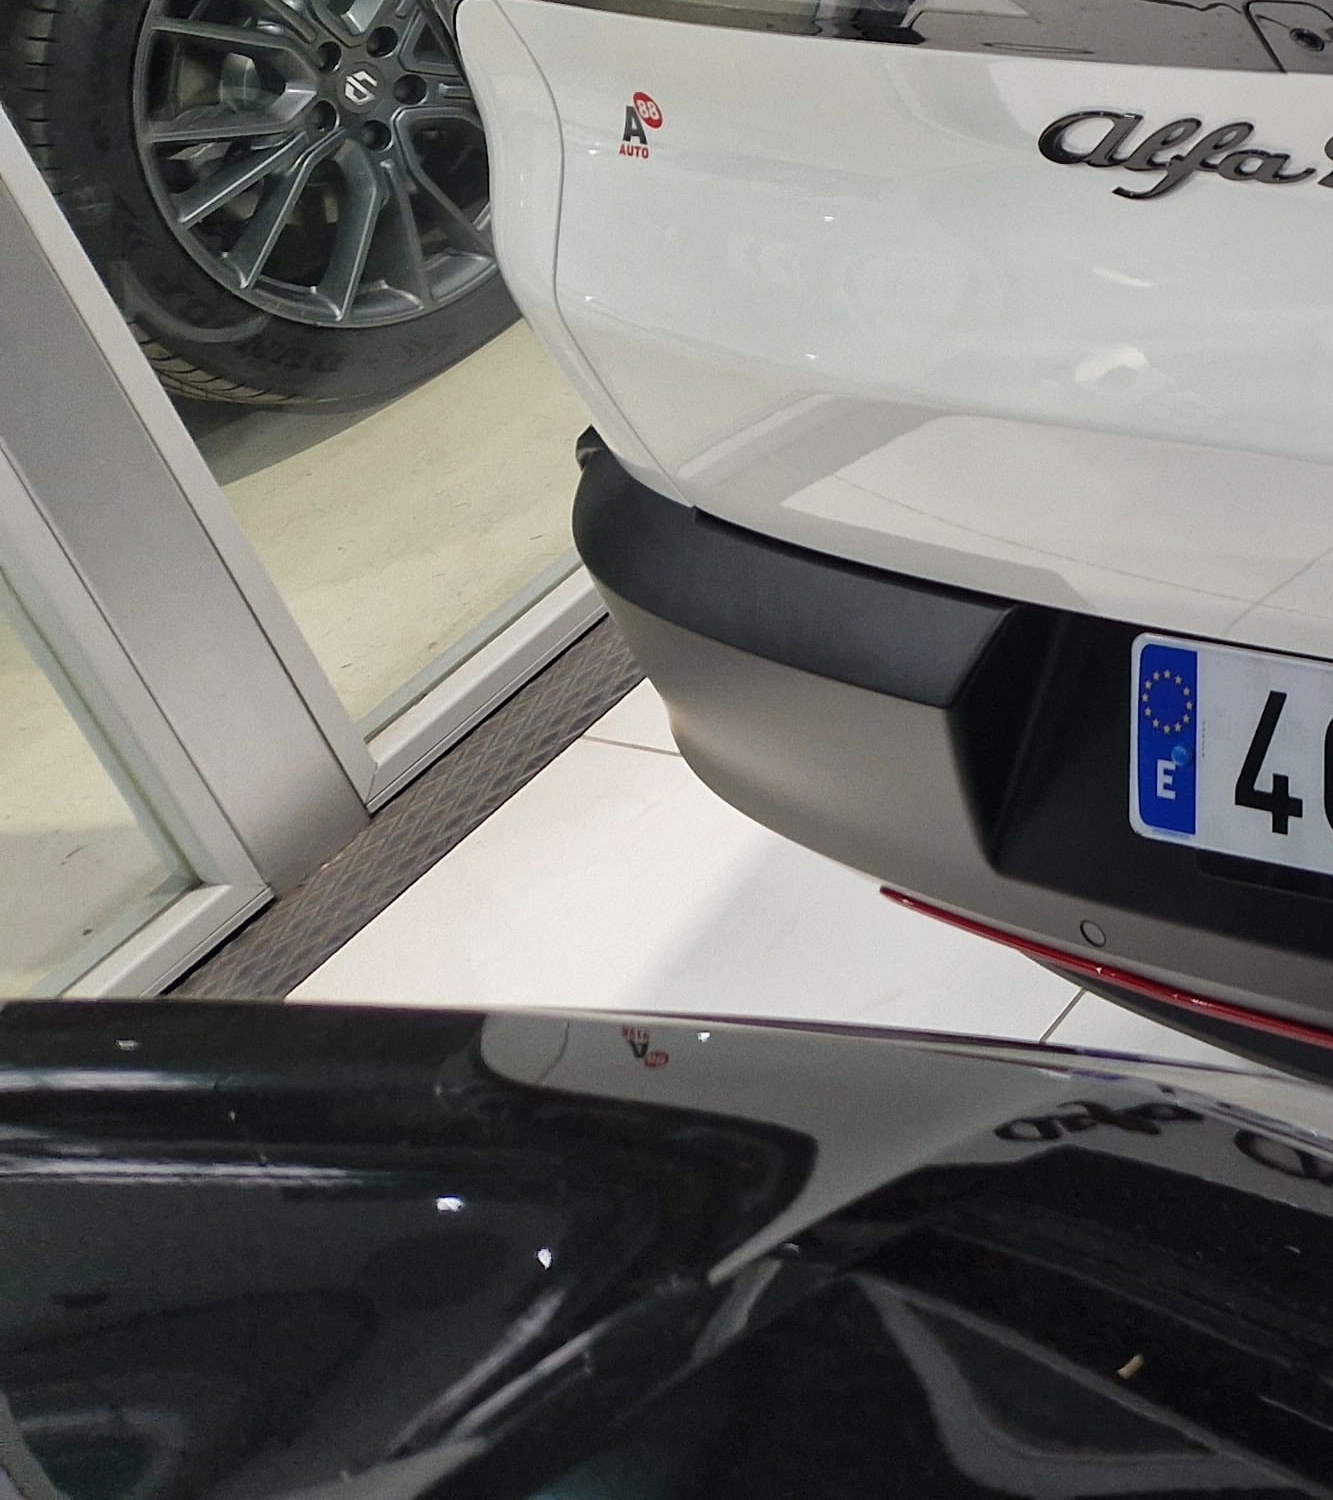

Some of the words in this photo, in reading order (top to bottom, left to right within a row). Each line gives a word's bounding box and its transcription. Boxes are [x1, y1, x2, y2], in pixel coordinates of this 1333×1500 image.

[618, 143, 650, 160] AUTO
[1038, 109, 1315, 200] Alfa
[1156, 758, 1177, 800] E
